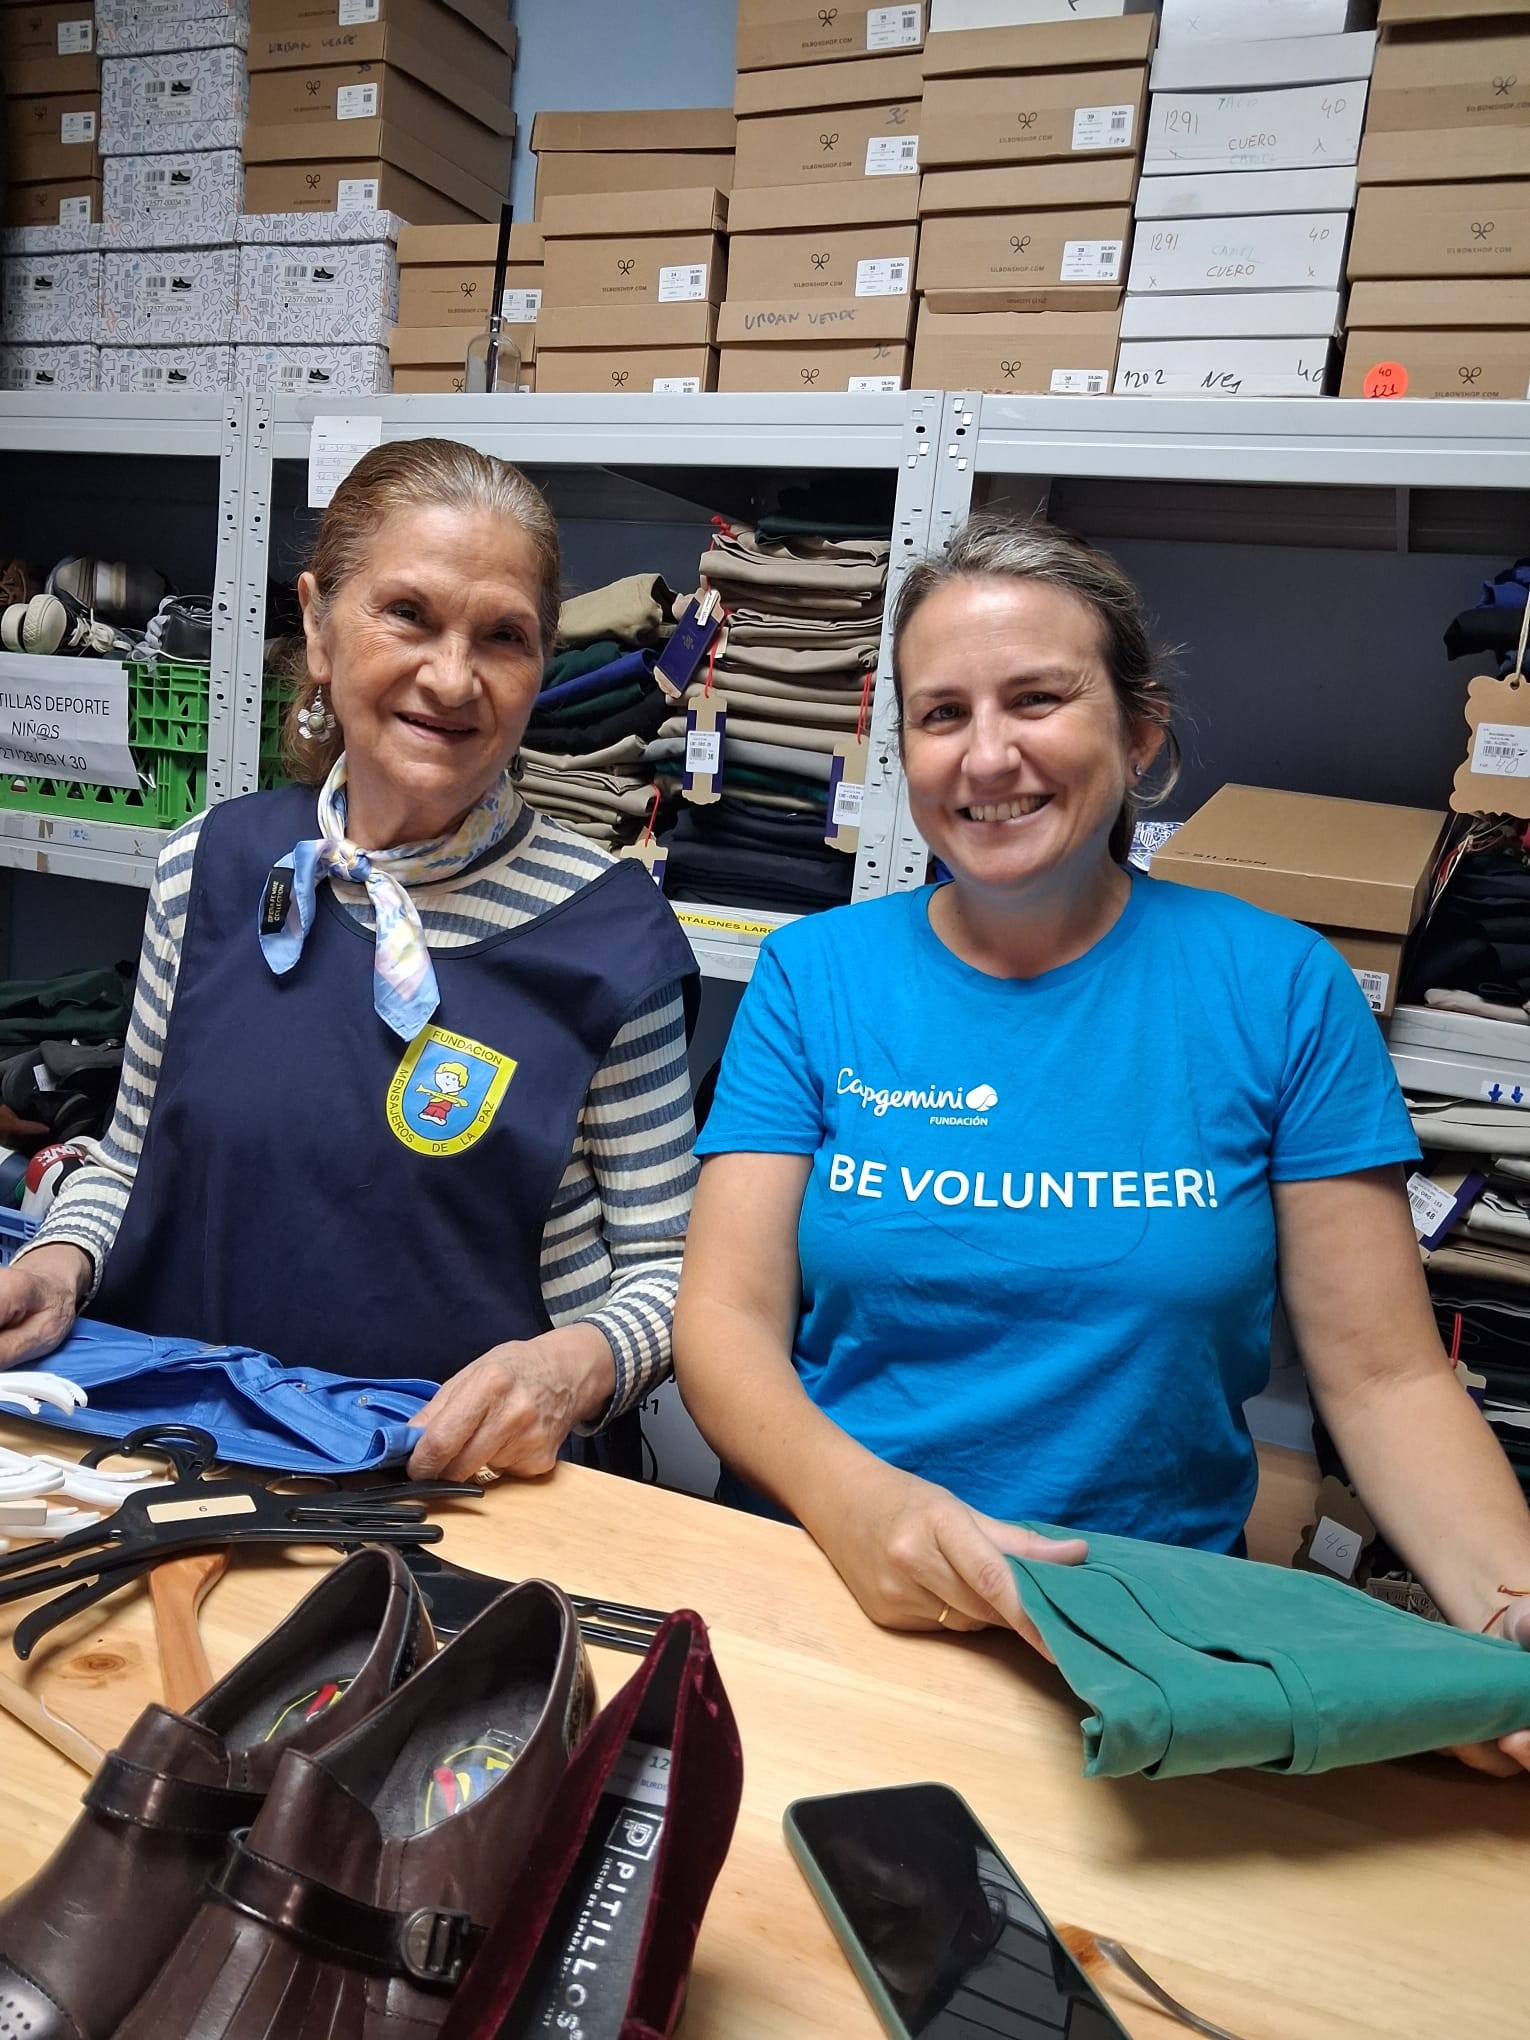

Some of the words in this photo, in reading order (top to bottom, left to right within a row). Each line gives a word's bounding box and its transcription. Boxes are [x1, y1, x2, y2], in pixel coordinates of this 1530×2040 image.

[1164, 110, 1198, 134] 1291
[1321, 98, 1347, 119] 40
[1228, 134, 1277, 151] CUERO
[1150, 233, 1179, 251] 1291
[1309, 228, 1330, 244] 40
[1206, 264, 1256, 278] CUERO
[1378, 367, 1392, 377] 40
[45, 696, 110, 716] DEPORTE
[11, 719, 60, 740] NIÑ@S
[57, 755, 66, 767] Y
[69, 755, 87, 771] 30
[432, 1030, 502, 1065] FUNDACION
[836, 1067, 963, 1117] Capgemini
[389, 1069, 415, 1143] MENSAJEROS
[432, 1143, 448, 1153] DE
[460, 1132, 476, 1146] LA
[478, 1101, 494, 1125] PAZ
[929, 1115, 988, 1127] FUNDACIÓN
[829, 1153, 888, 1199] BE
[900, 1166, 1219, 1209] VOLUNTEER!
[1324, 1532, 1351, 1558] 46
[648, 1756, 671, 1771] 12
